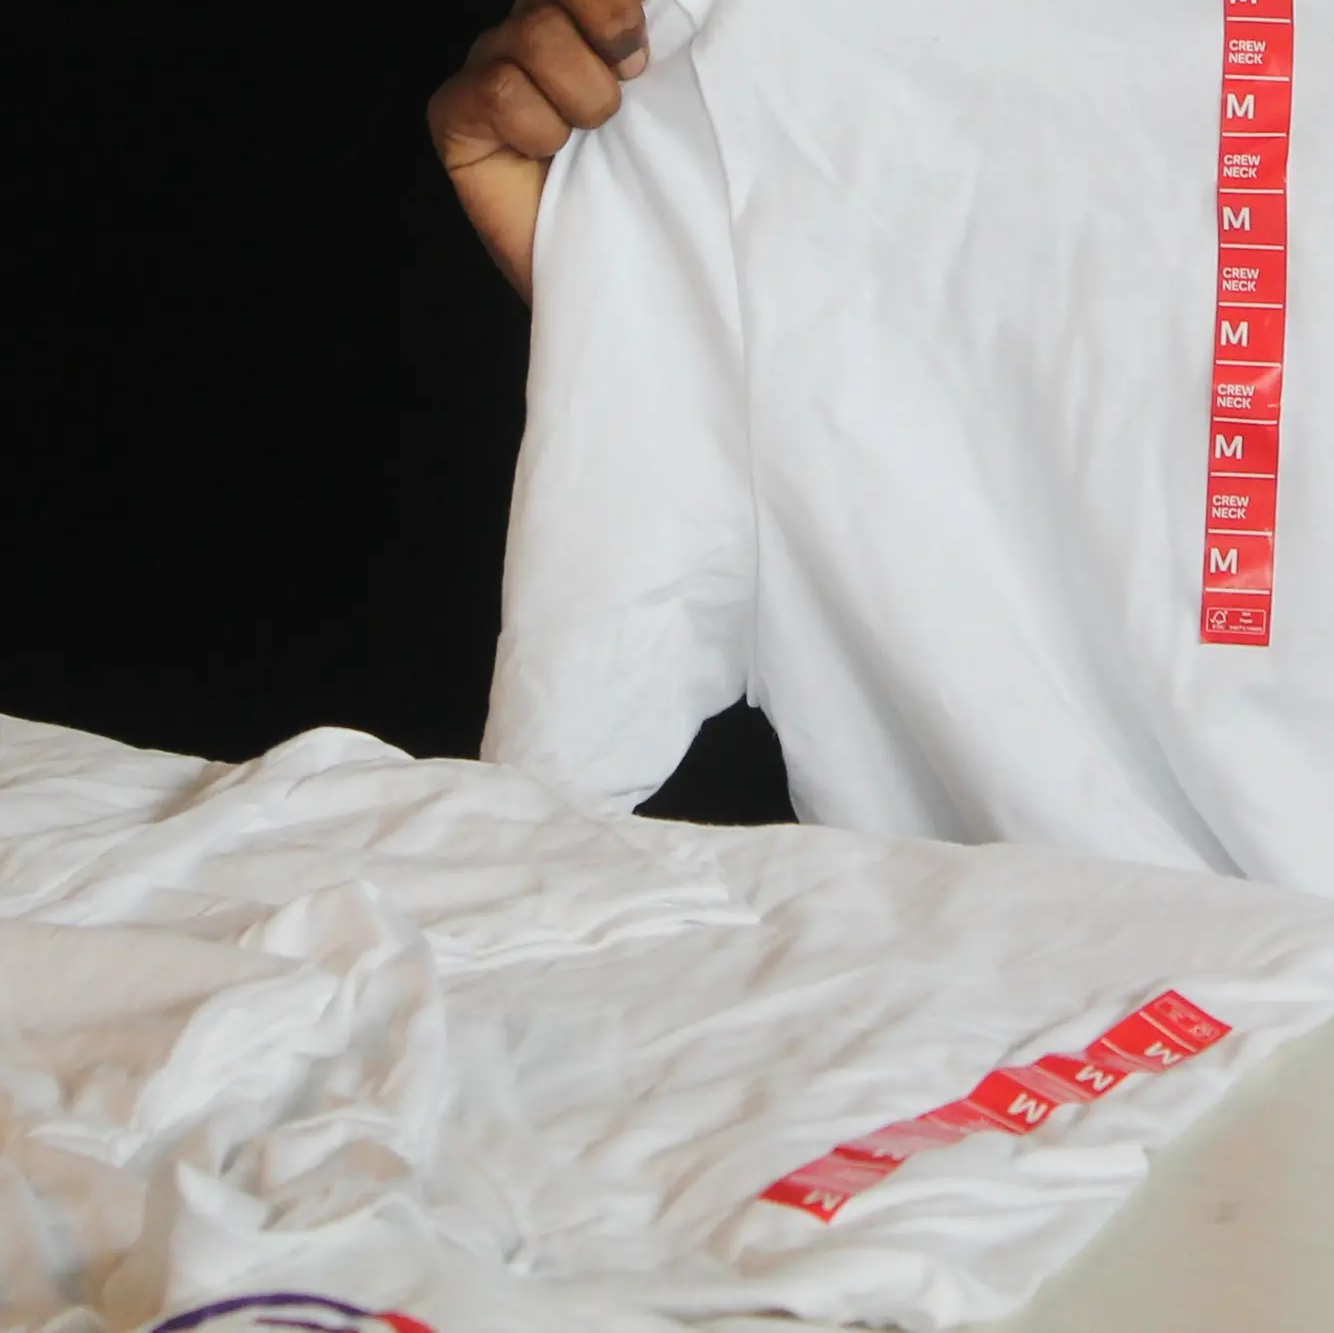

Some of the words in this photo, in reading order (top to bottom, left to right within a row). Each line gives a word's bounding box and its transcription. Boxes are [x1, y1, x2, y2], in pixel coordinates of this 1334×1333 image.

[1228, 39, 1266, 52] CREW
[1228, 52, 1263, 65] NECK
[1226, 93, 1256, 120] M
[1223, 154, 1261, 167] CREW
[1223, 166, 1257, 179] NECK
[1222, 206, 1252, 232] M
[1222, 267, 1260, 280] CREW
[1222, 280, 1257, 293] NECK
[1219, 320, 1249, 348] M
[1216, 383, 1255, 397] CREW
[1216, 396, 1252, 410] NECK
[1214, 434, 1244, 460] M
[1212, 495, 1250, 508] CREW
[1211, 507, 1247, 520] NECK
[1209, 547, 1239, 575] M
[1143, 1040, 1183, 1065] M
[1074, 1064, 1115, 1092] M
[1007, 1092, 1049, 1124] M
